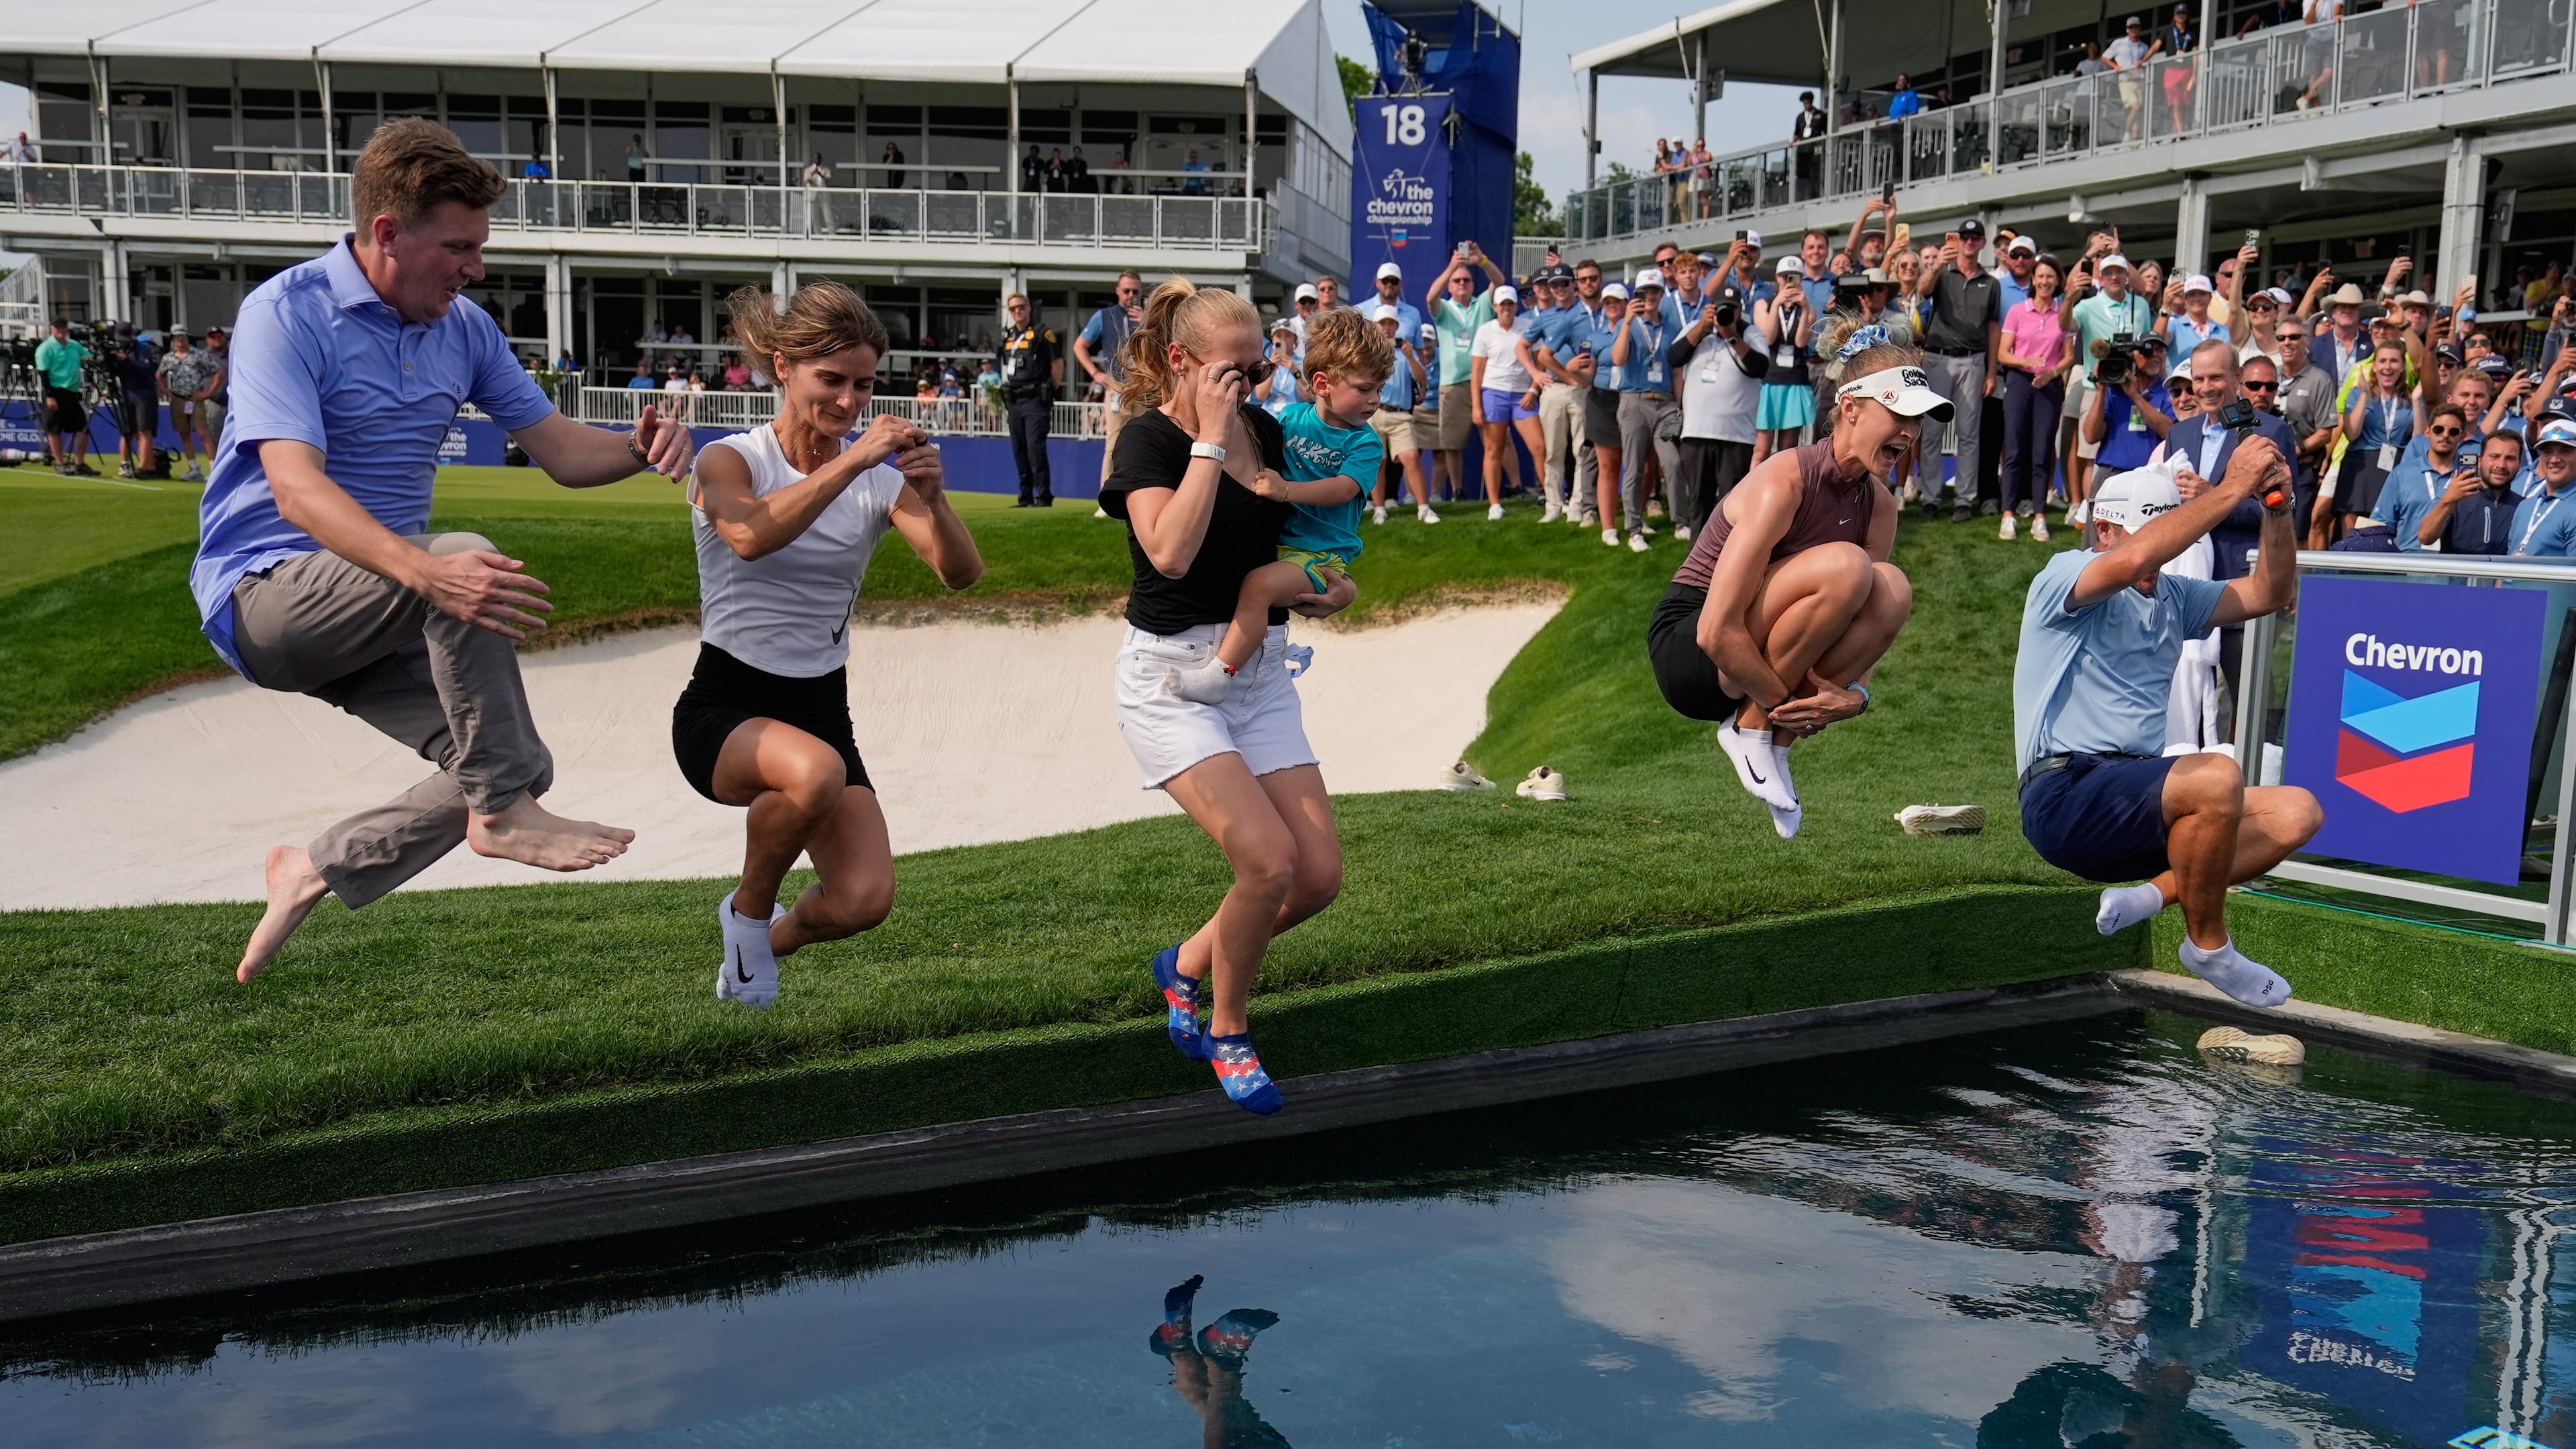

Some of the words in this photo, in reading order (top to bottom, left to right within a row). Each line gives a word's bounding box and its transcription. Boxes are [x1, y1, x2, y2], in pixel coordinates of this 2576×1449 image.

[1381, 104, 1426, 146] 18
[1407, 184, 1434, 200] the
[1367, 197, 1434, 215] chevron
[1366, 214, 1433, 226] championship
[450, 431, 467, 441] the
[2101, 508, 2125, 520] DELTA
[2345, 633, 2483, 676] Chevron
